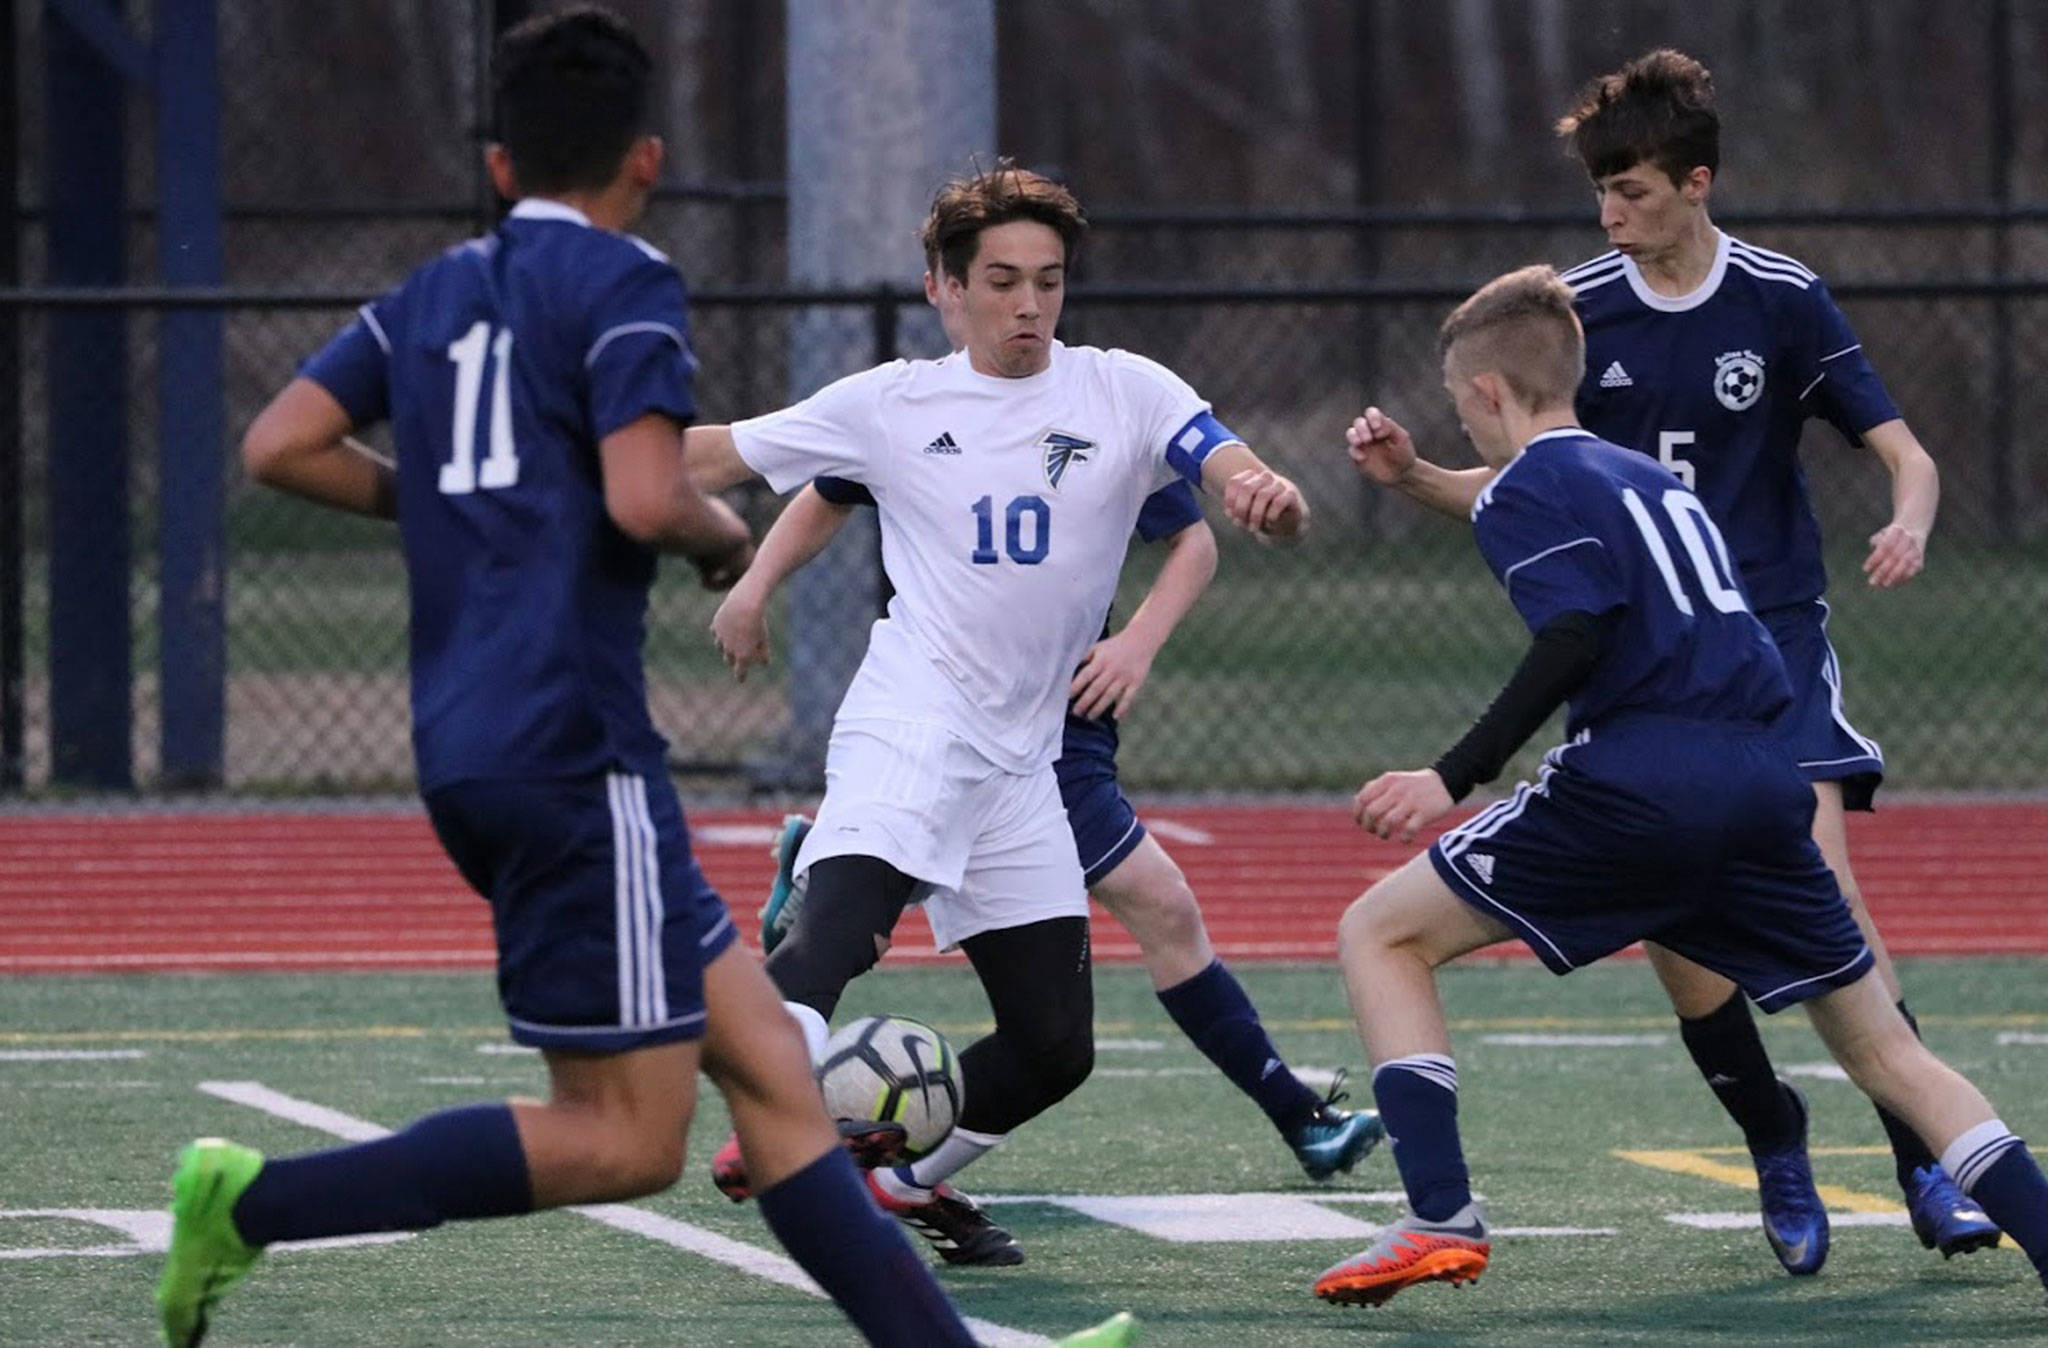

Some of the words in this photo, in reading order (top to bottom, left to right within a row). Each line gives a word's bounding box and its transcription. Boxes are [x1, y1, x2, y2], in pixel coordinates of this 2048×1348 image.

[438, 320, 520, 494] 11
[923, 446, 962, 455] adidas
[1659, 431, 1695, 492] 5
[971, 495, 1050, 565] 10
[1622, 488, 1750, 616] 10
